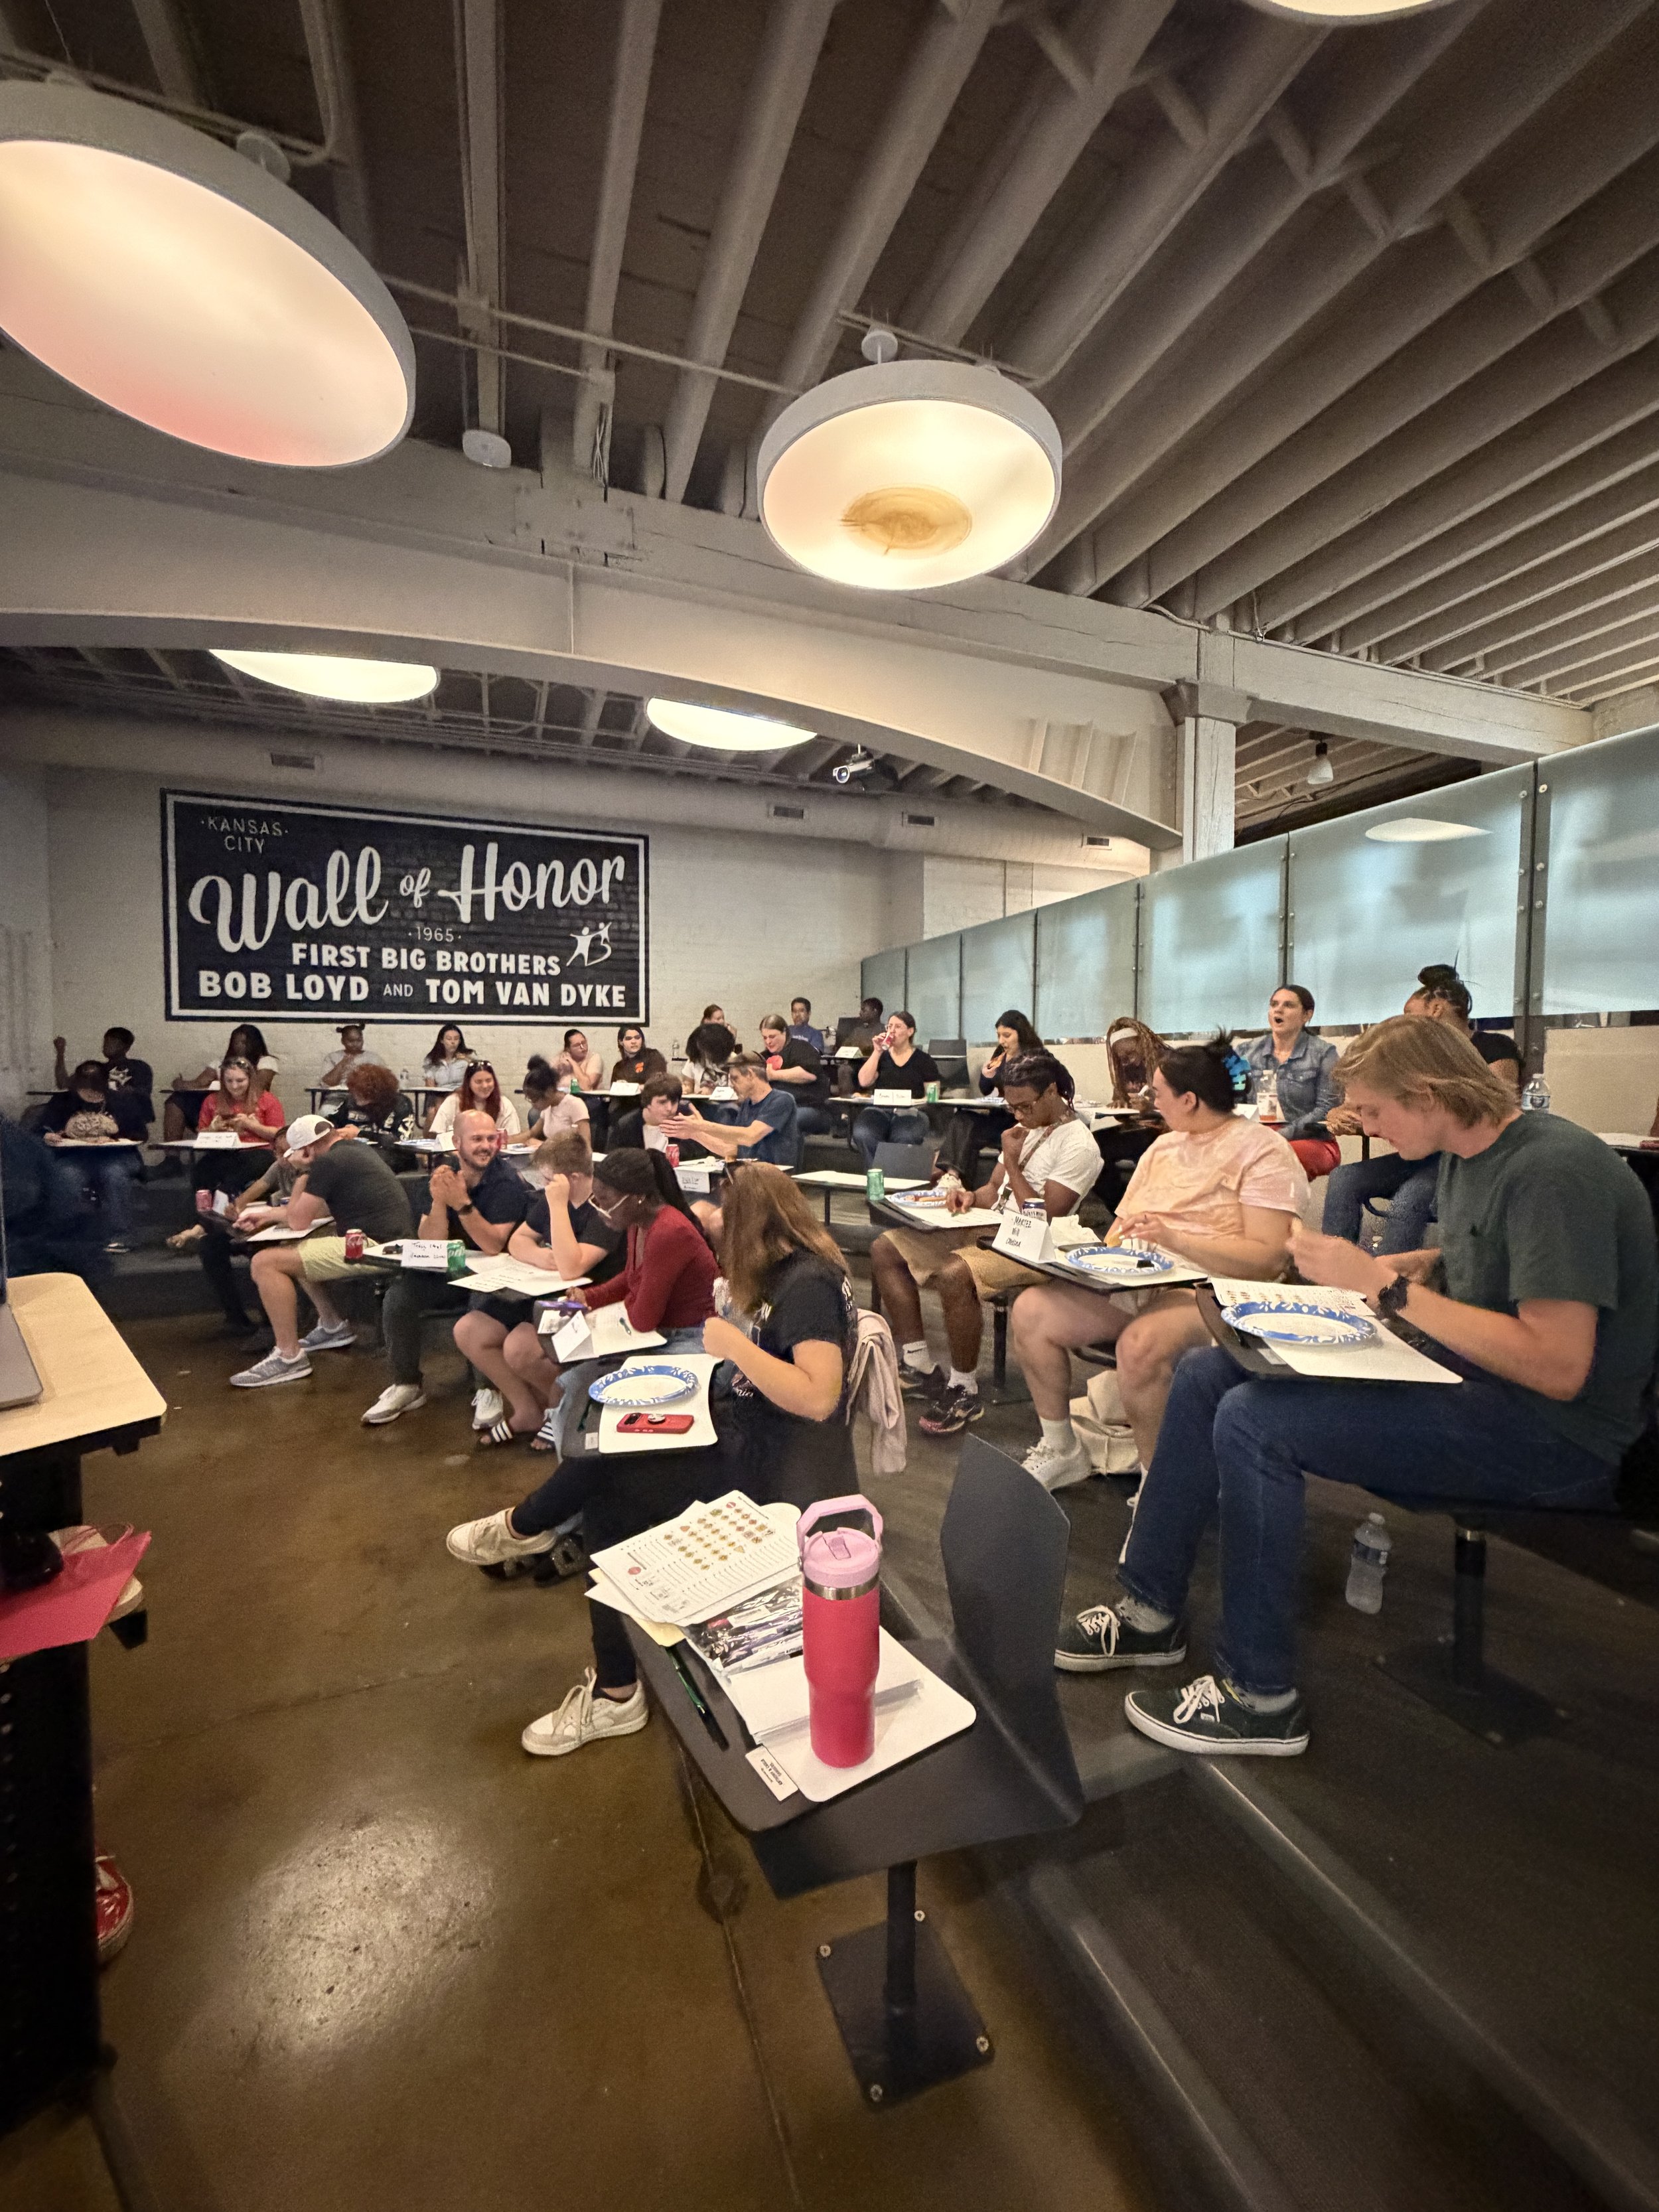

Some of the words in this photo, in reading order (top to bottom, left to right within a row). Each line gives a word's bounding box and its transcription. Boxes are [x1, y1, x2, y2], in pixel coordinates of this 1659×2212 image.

[207, 816, 283, 837] KANSAS
[224, 835, 265, 854] CITY
[188, 846, 390, 953] Wall
[399, 867, 431, 909] of
[437, 842, 626, 924] Honor
[416, 926, 455, 942] 1965
[291, 942, 371, 968] FIRST
[381, 947, 427, 971] BIG
[436, 950, 561, 976] BROTHERS
[199, 970, 273, 999] BOB
[285, 973, 370, 1001] LOYD
[383, 983, 413, 997] AND
[425, 978, 485, 1005] TOM
[494, 981, 550, 1006] VAN
[560, 983, 626, 1008] DYKE
